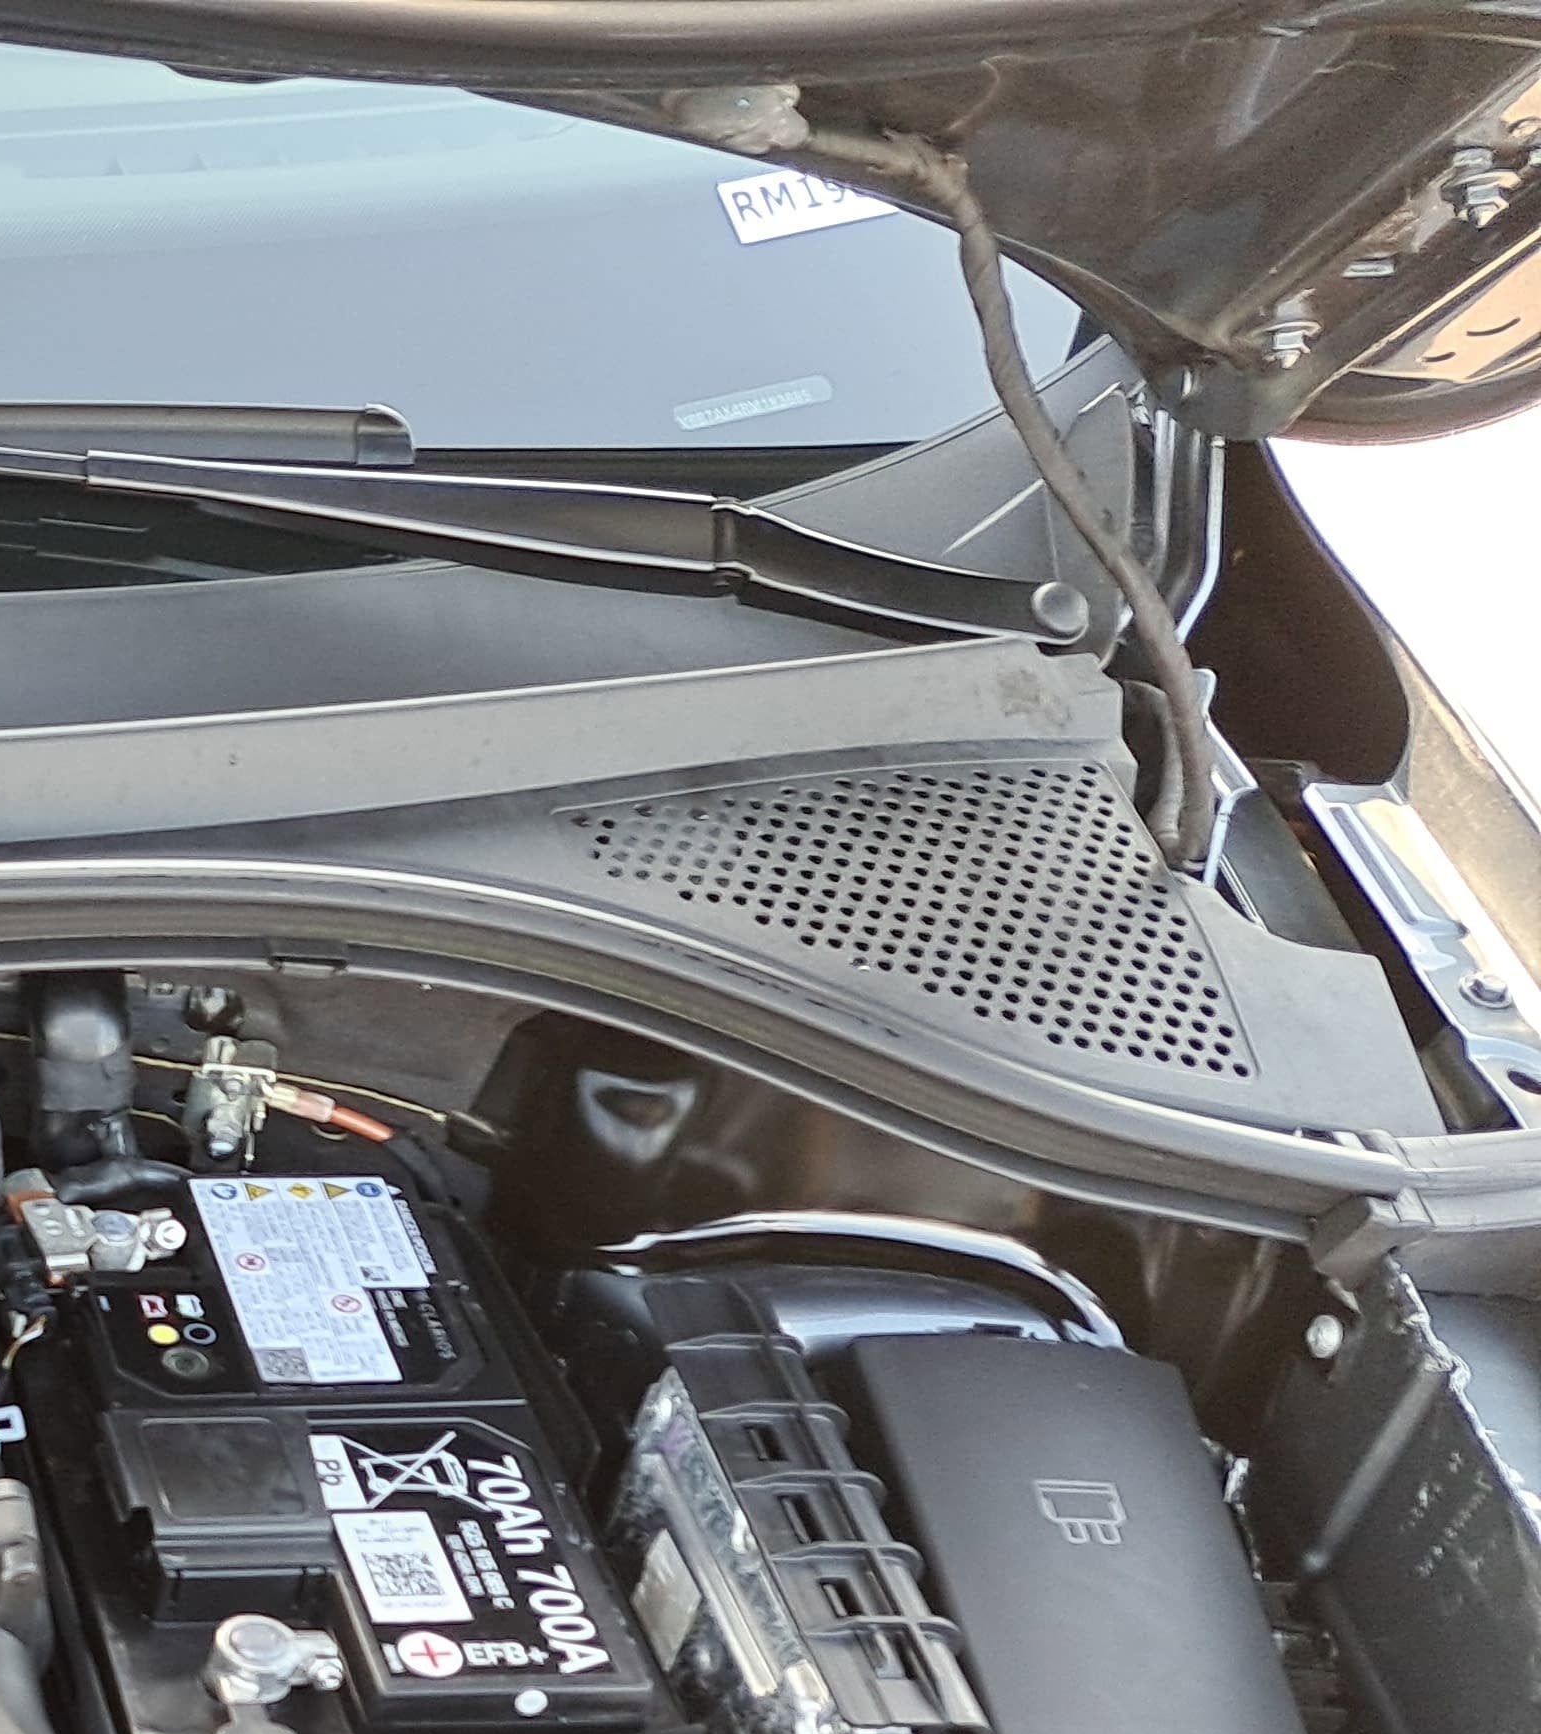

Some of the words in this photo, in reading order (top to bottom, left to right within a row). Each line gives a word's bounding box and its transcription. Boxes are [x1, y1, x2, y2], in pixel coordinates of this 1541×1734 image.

[314, 1458, 341, 1487] Pb
[467, 1454, 553, 1556] 70Ah
[516, 1564, 611, 1675] 700A
[462, 1638, 550, 1667] EFB+
